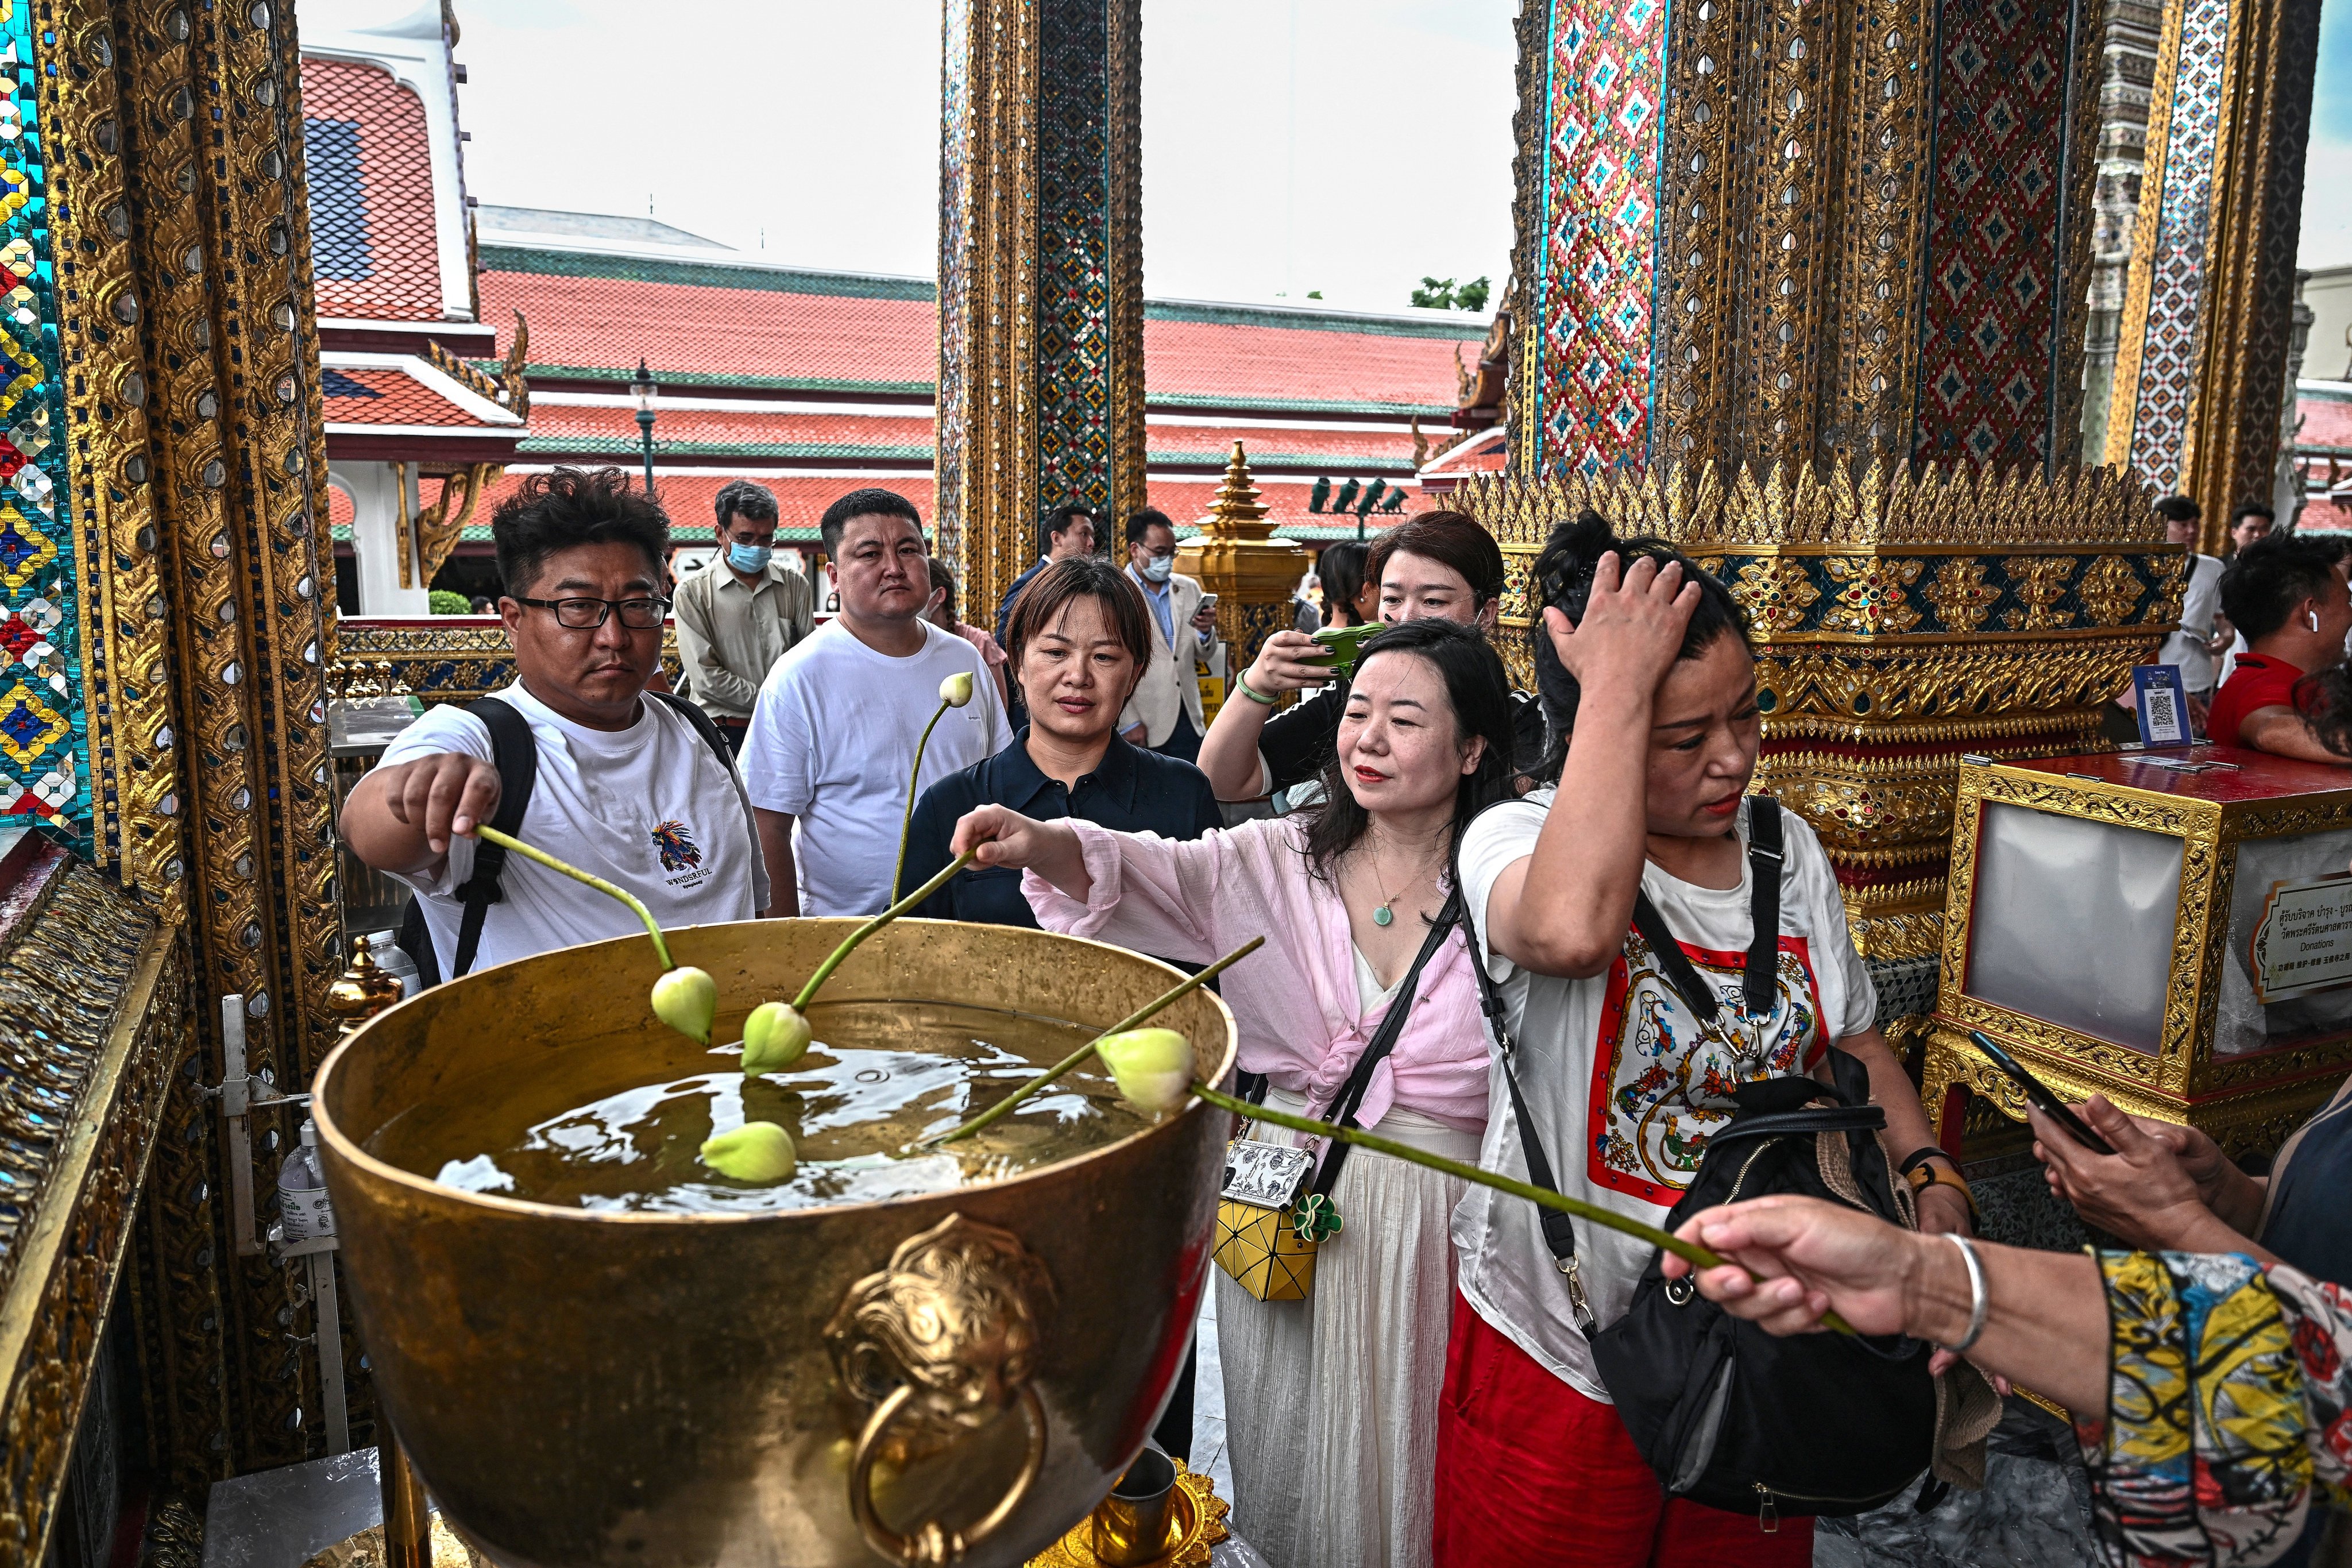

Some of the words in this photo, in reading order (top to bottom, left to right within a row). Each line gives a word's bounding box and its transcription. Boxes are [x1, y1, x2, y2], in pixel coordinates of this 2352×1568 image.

[2280, 908, 2315, 927] ตู้รับบริจาค
[2317, 905, 2333, 920] บำรุง
[2300, 940, 2334, 952] Donations
